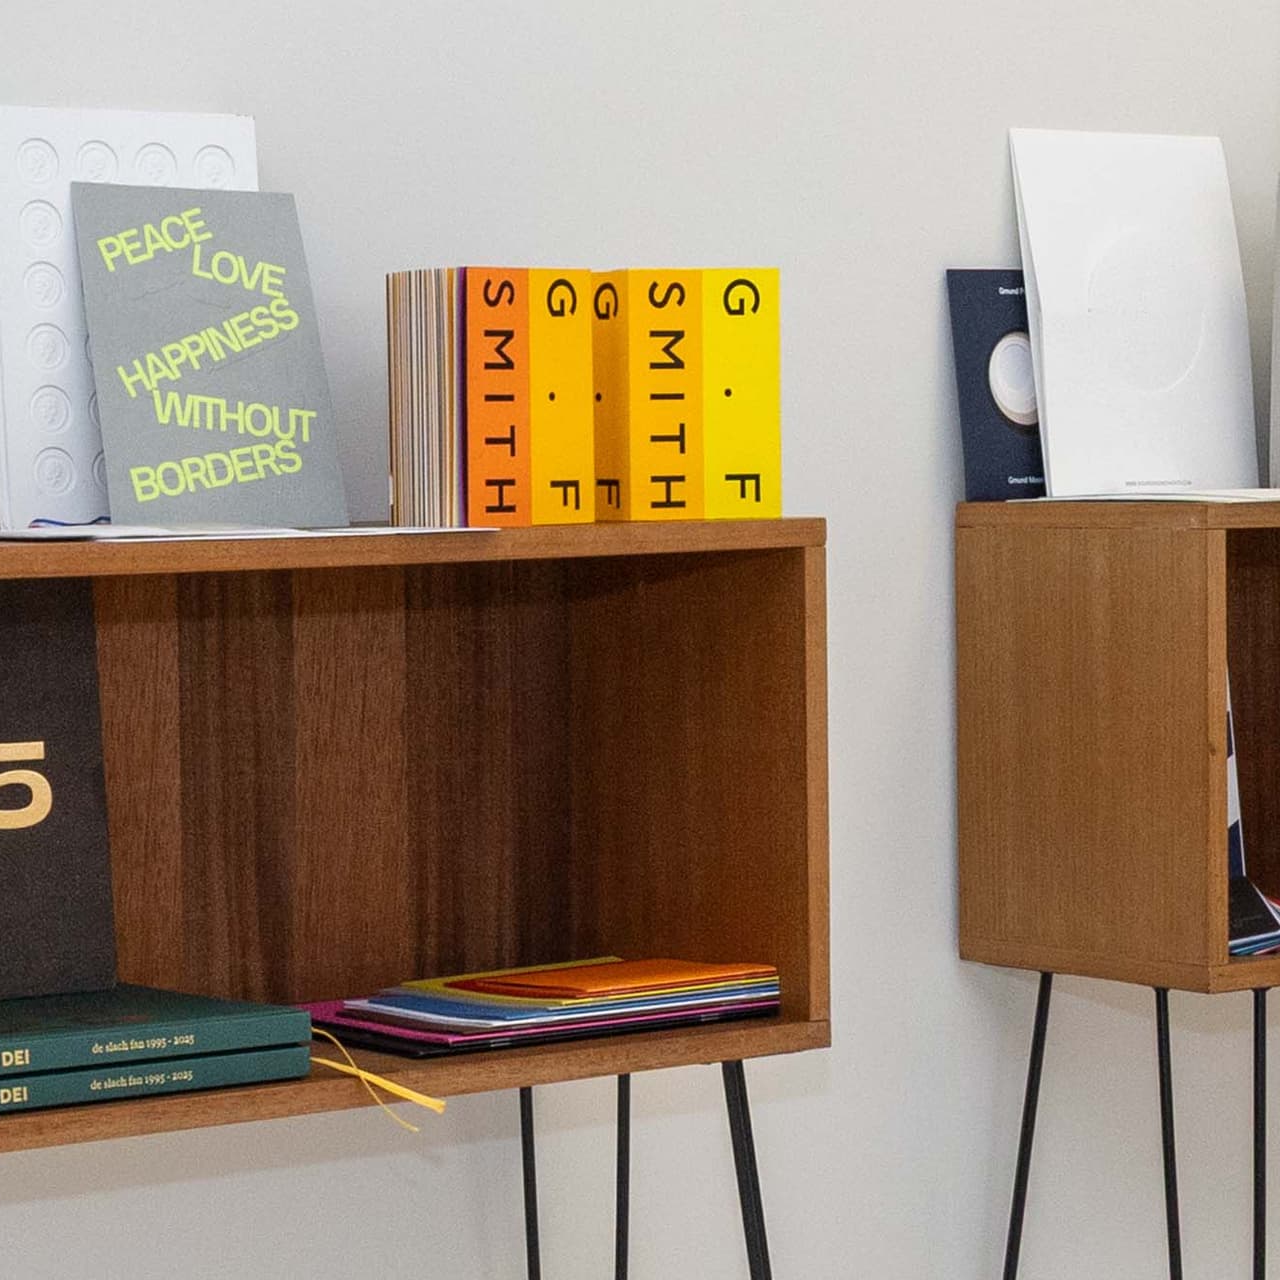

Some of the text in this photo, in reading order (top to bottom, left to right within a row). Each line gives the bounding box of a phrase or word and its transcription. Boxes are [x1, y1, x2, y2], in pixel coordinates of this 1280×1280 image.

[97, 207, 213, 272] PEACE
[191, 244, 286, 300] LOVE
[117, 297, 300, 398] HAPPINESS
[150, 389, 317, 444] WITHOUT
[483, 279, 516, 513] SMITH
[648, 281, 686, 509] SMITH
[130, 440, 303, 503] BORDERS
[1, 1048, 30, 1067] DEI
[91, 1043, 103, 1054] de
[105, 1039, 129, 1053] slach
[129, 1038, 145, 1051] fan
[146, 1037, 167, 1049] 1995
[173, 1034, 195, 1046] 2025
[0, 1086, 28, 1104] DEI
[90, 1080, 102, 1091] de
[103, 1077, 128, 1089] slach
[128, 1076, 144, 1088] fan
[144, 1074, 165, 1086] 1995
[172, 1070, 194, 1083] 2025
